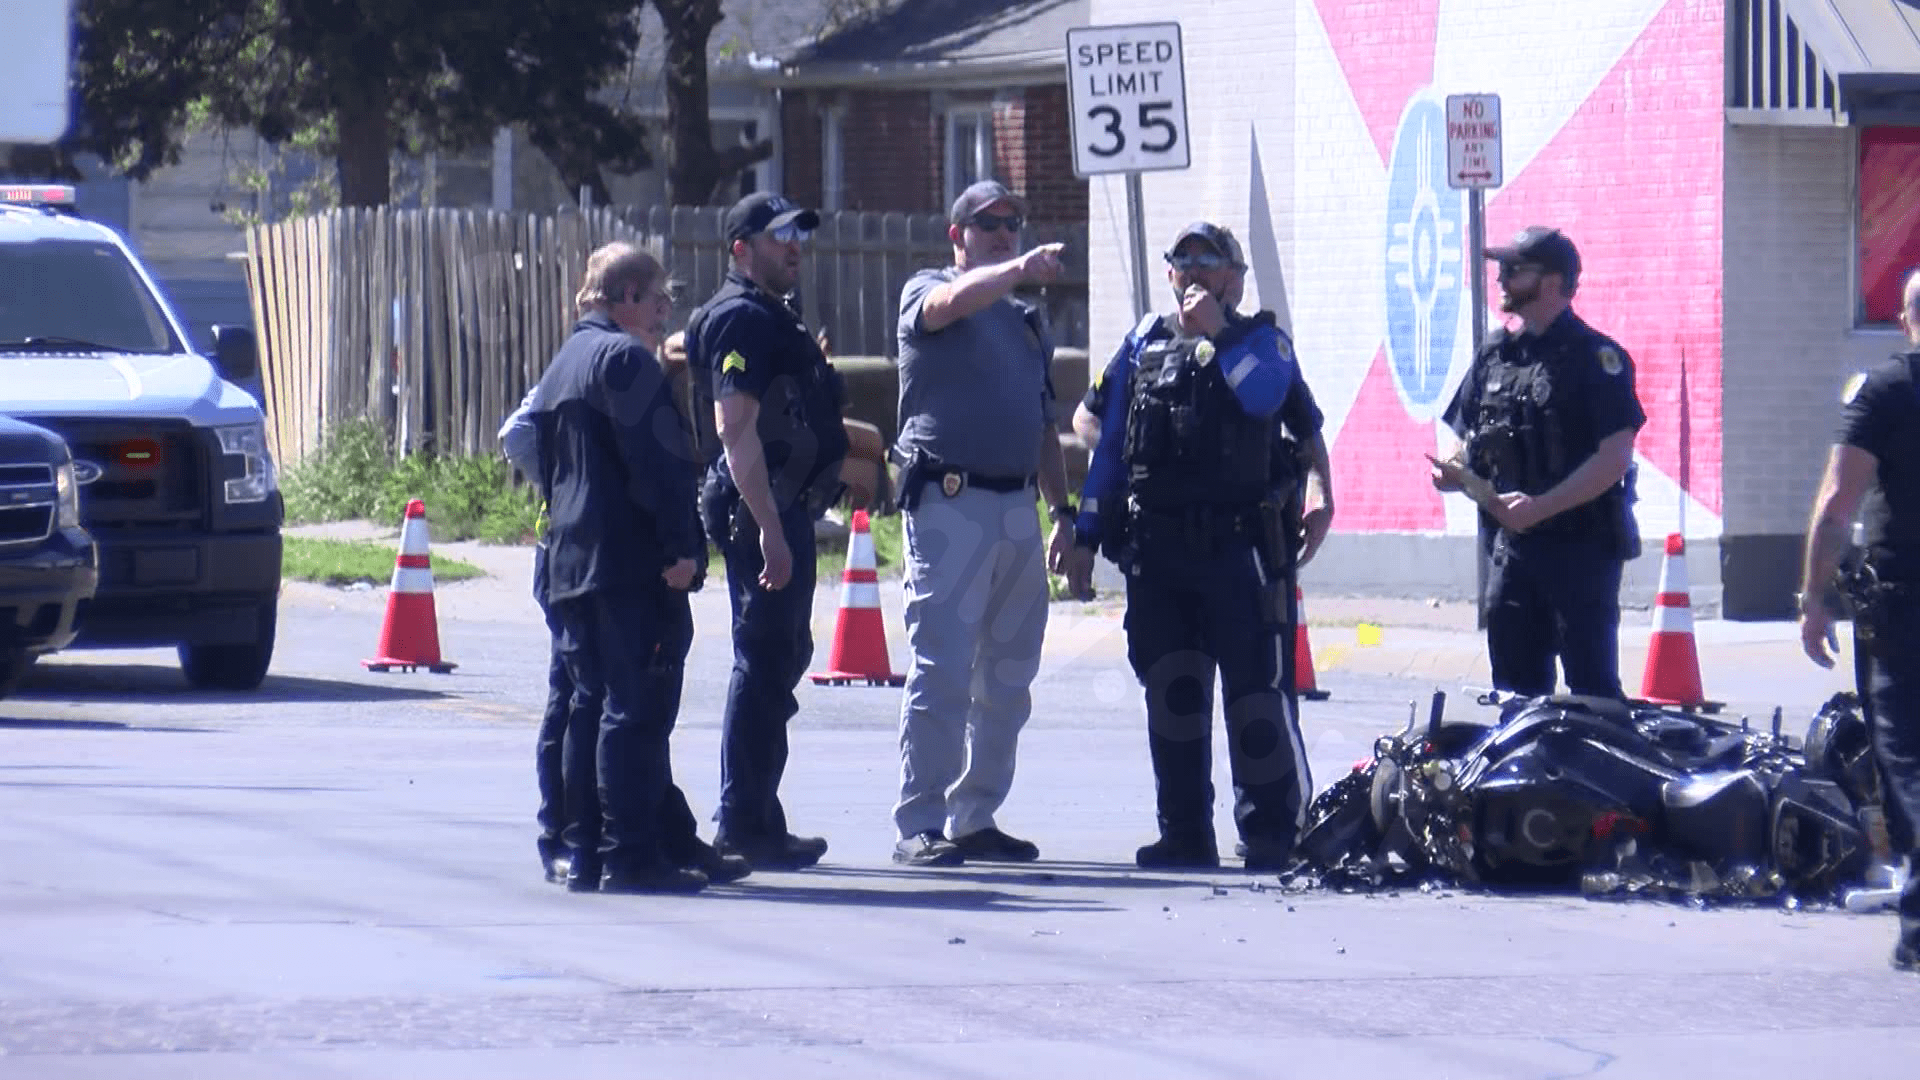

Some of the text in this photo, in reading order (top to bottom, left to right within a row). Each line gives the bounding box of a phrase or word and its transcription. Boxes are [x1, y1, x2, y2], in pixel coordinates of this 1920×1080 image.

[1078, 40, 1173, 67] SPEED
[1089, 70, 1163, 97] LIMIT
[1463, 101, 1484, 119] NO
[1087, 101, 1178, 158] 35
[1448, 121, 1498, 140] PARKING
